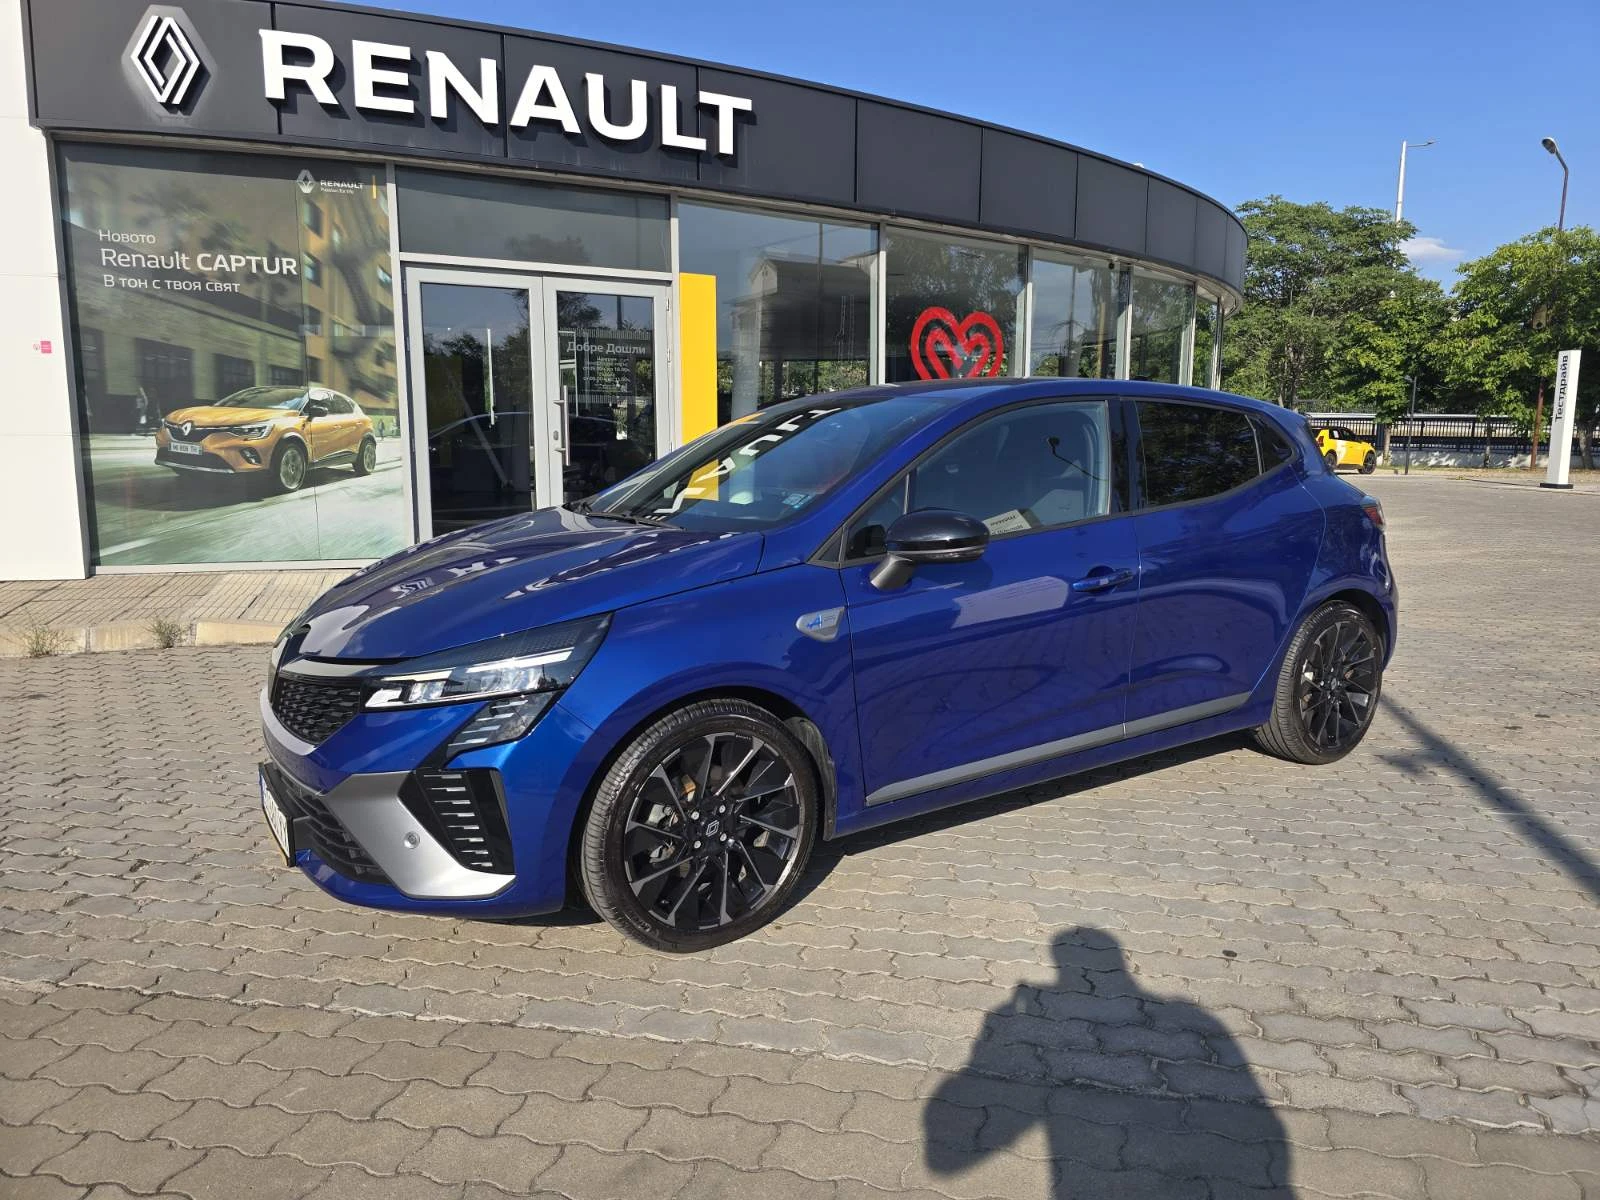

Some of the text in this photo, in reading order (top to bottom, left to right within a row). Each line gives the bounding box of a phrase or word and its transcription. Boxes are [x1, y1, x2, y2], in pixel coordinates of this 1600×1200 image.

[258, 28, 753, 156] RENAULT
[320, 180, 364, 189] RENAULT
[99, 229, 156, 244] Новото
[100, 249, 298, 275] Renault CAPTUR
[103, 274, 240, 293] В тон с твоя свят
[567, 341, 646, 354] Добре Дошли
[1555, 355, 1569, 421] Тестдрайв
